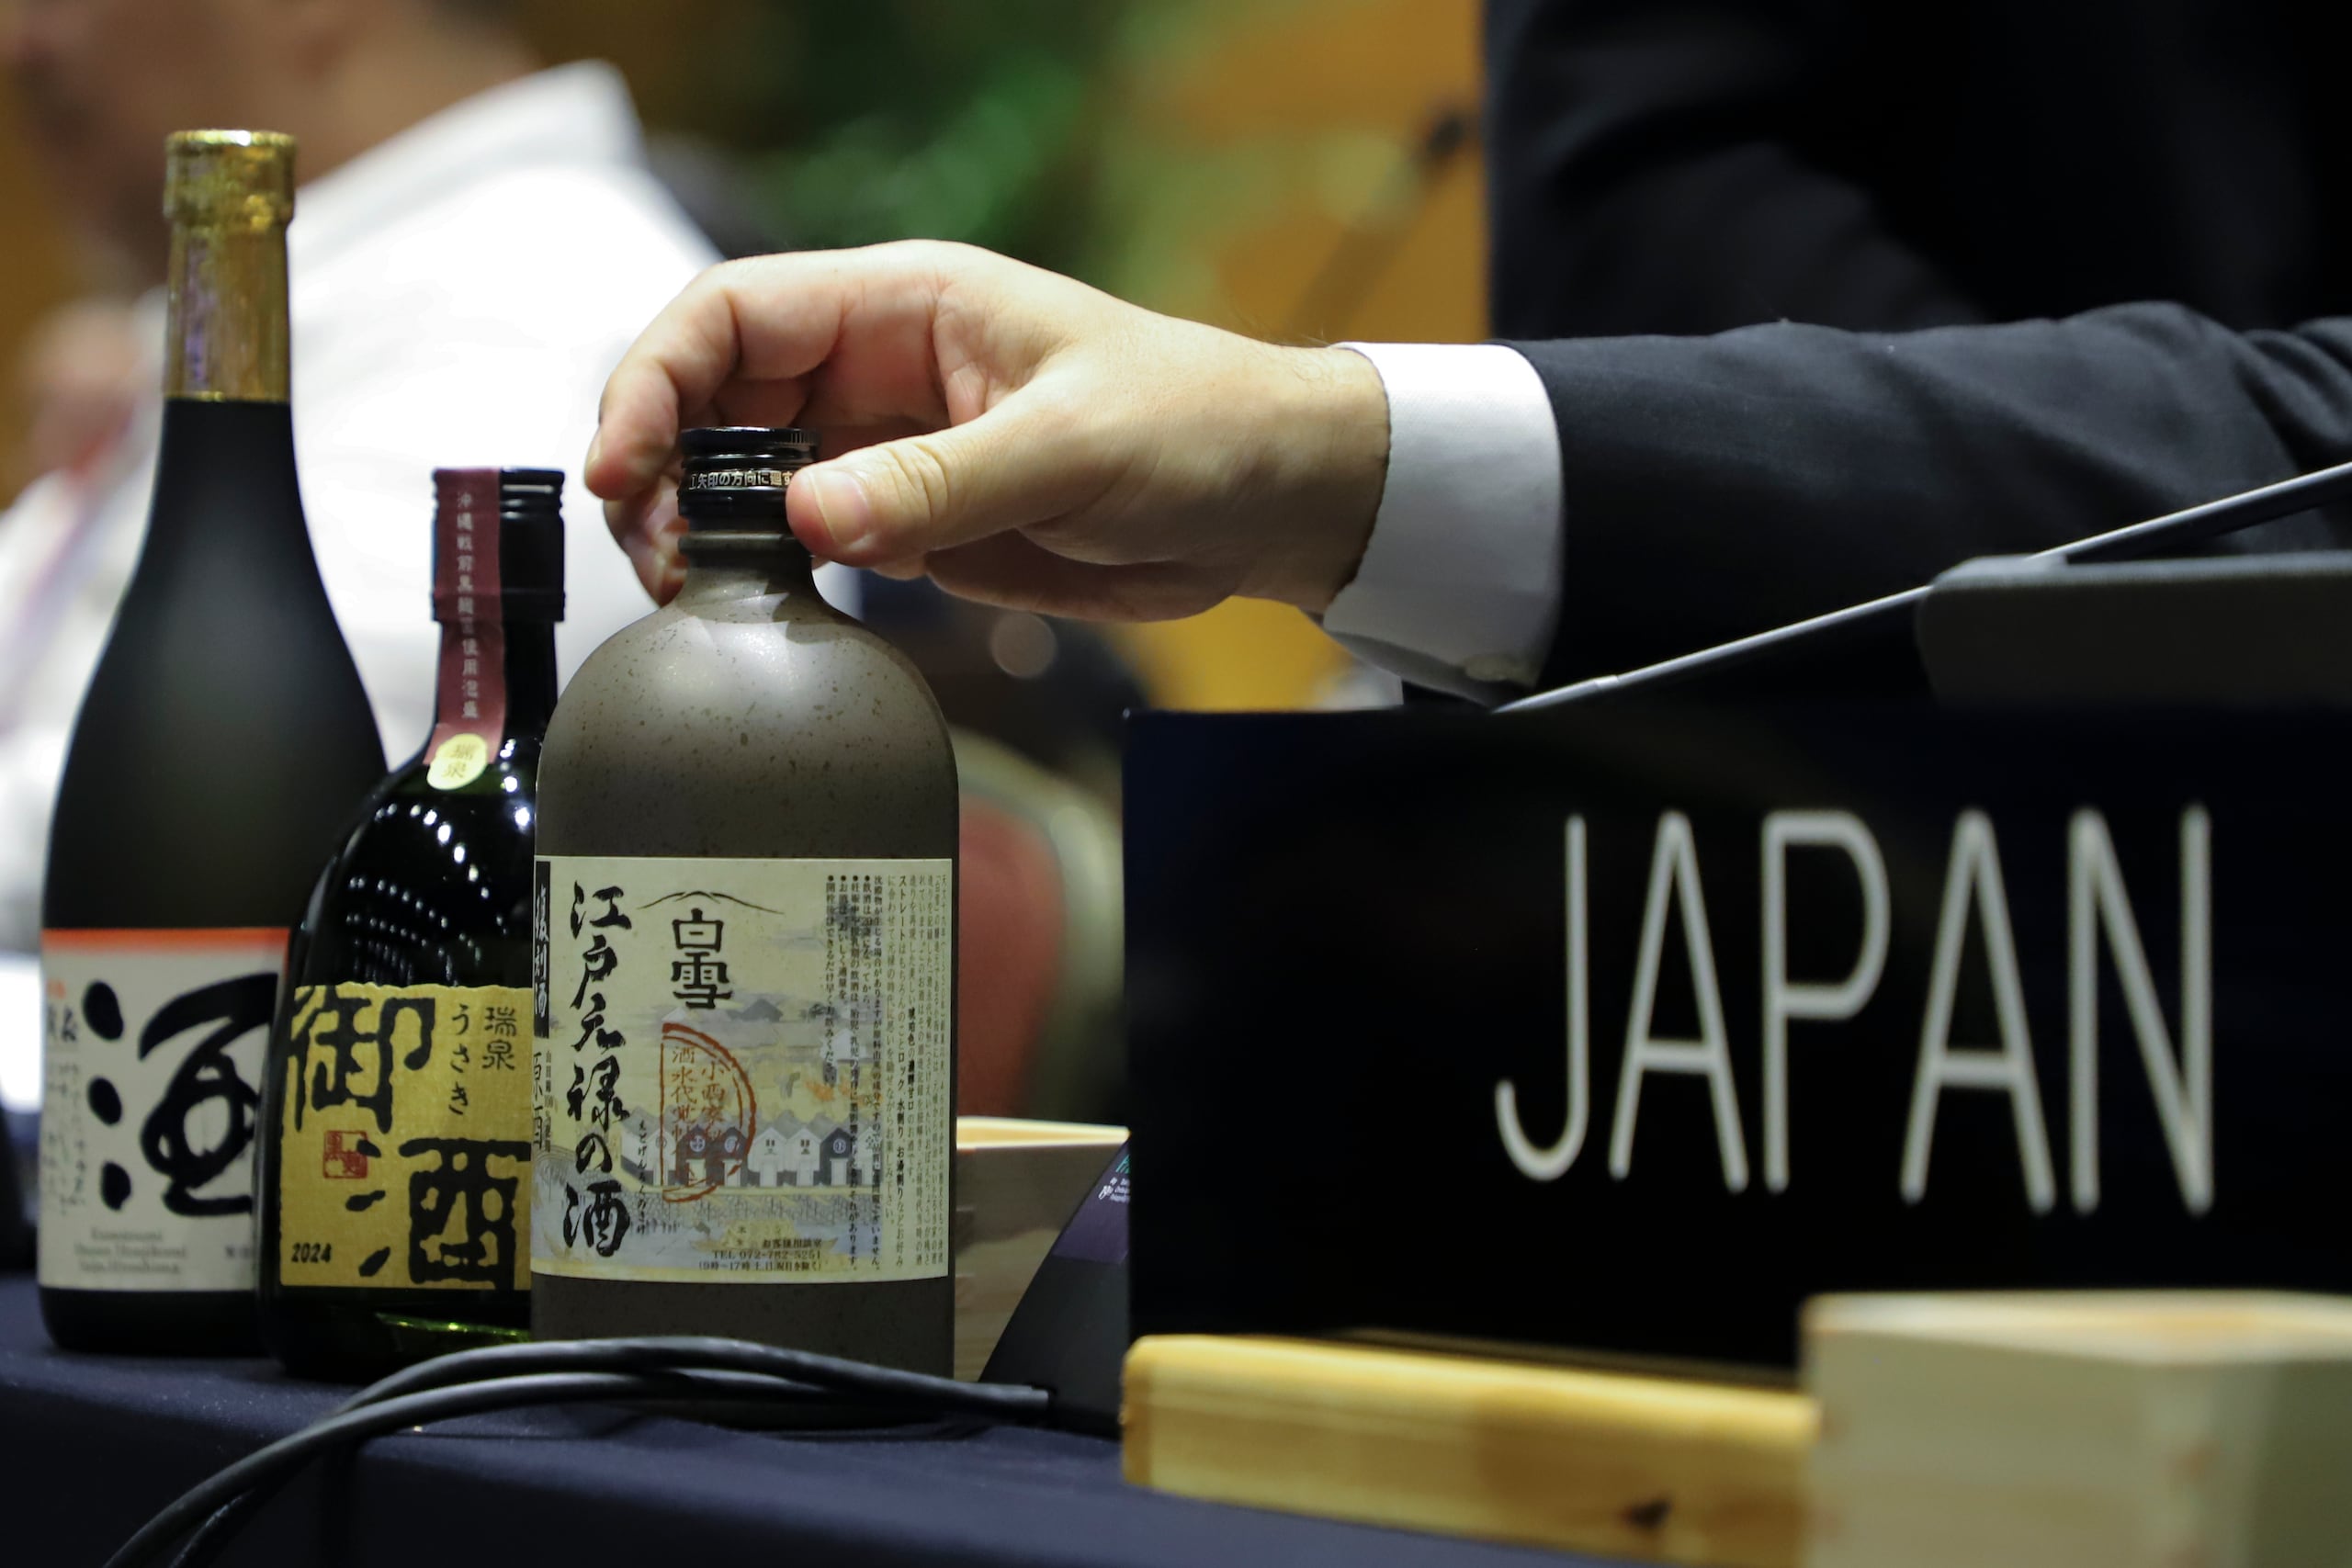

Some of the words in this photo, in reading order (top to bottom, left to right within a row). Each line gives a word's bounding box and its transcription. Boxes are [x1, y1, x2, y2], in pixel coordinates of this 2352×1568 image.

[670, 907, 734, 1010] 白雪
[481, 1005, 517, 1071] 瑞泉
[1495, 805, 2215, 1214] JAPAN
[562, 880, 633, 1258] 江戸元禄の酒
[291, 1242, 333, 1263] 2024
[713, 1249, 736, 1259] TEL
